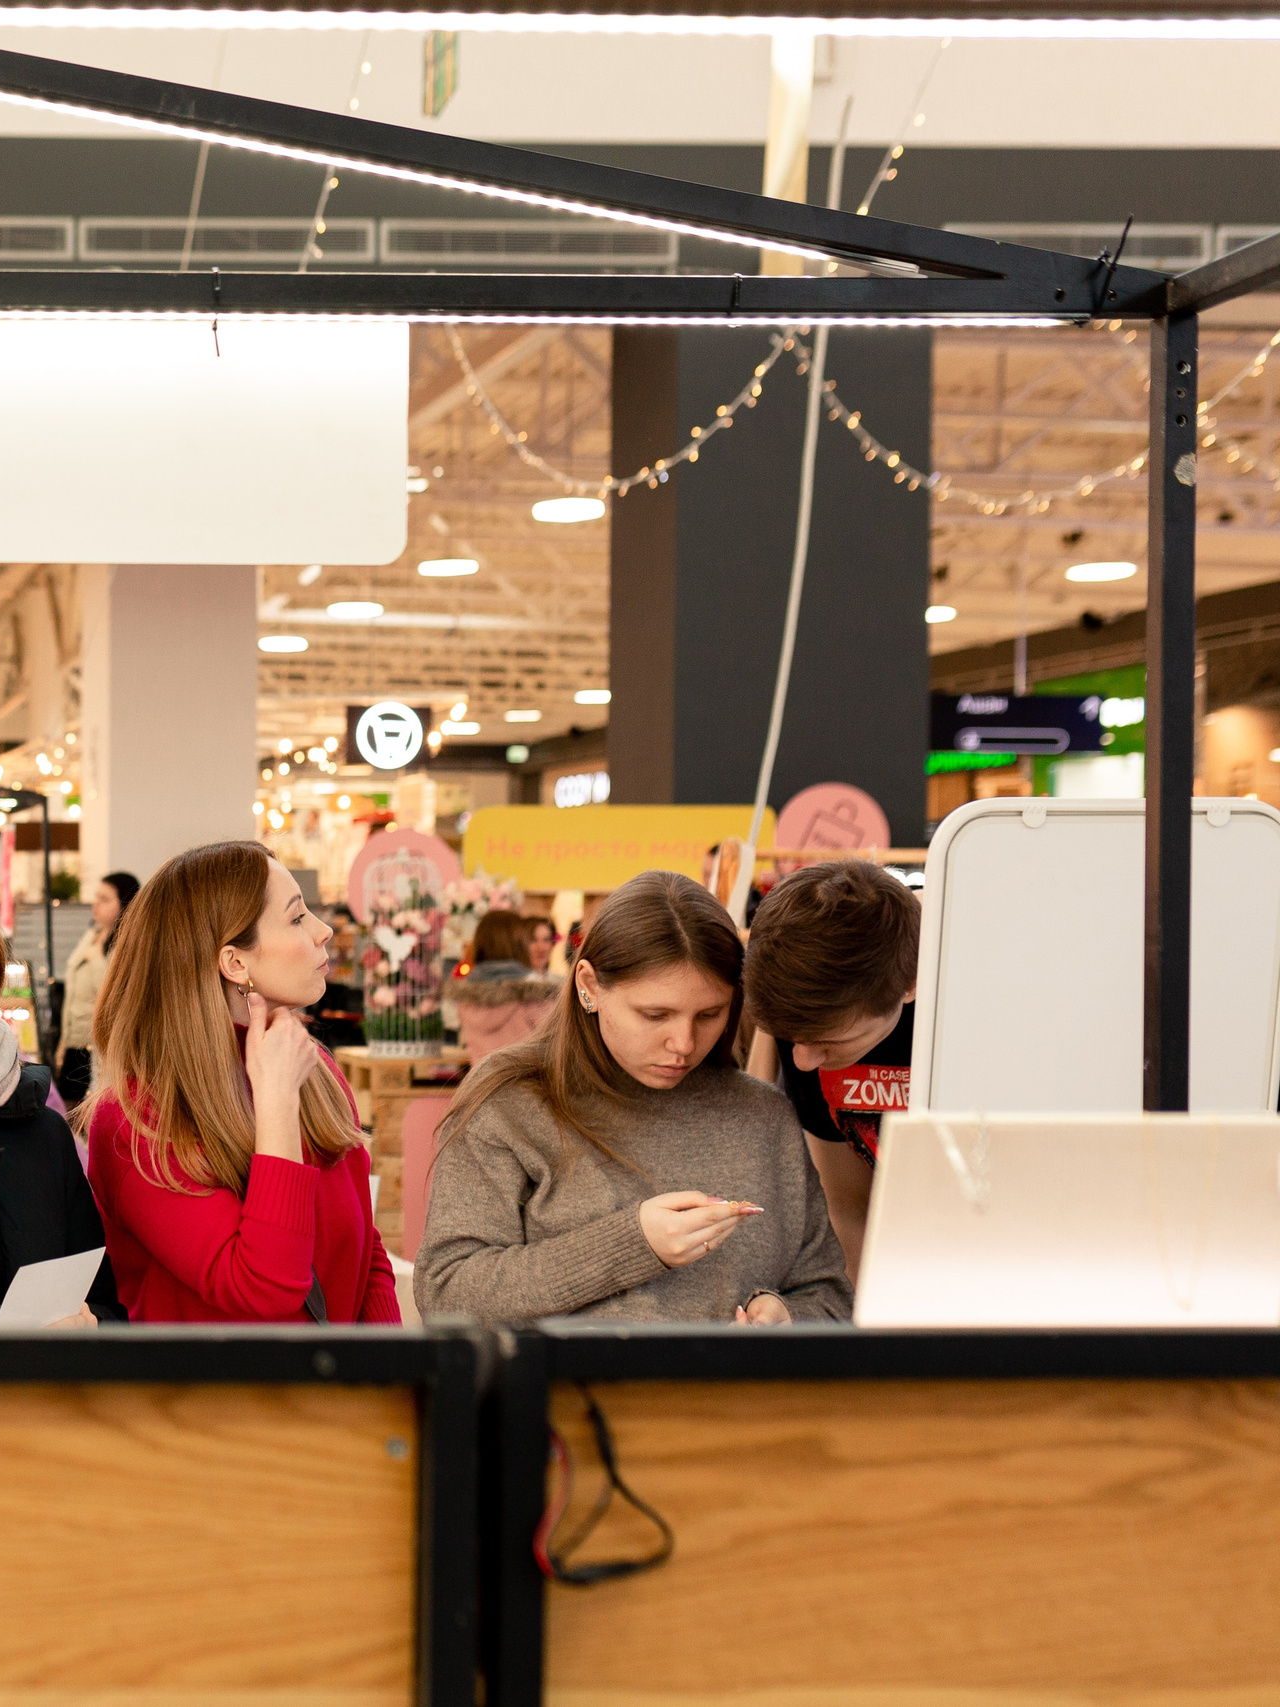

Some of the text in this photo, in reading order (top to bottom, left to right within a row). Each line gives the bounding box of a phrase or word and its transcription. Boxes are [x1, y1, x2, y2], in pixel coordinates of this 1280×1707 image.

[486, 835, 707, 865] Не просто мар
[880, 1069, 910, 1081] CASE
